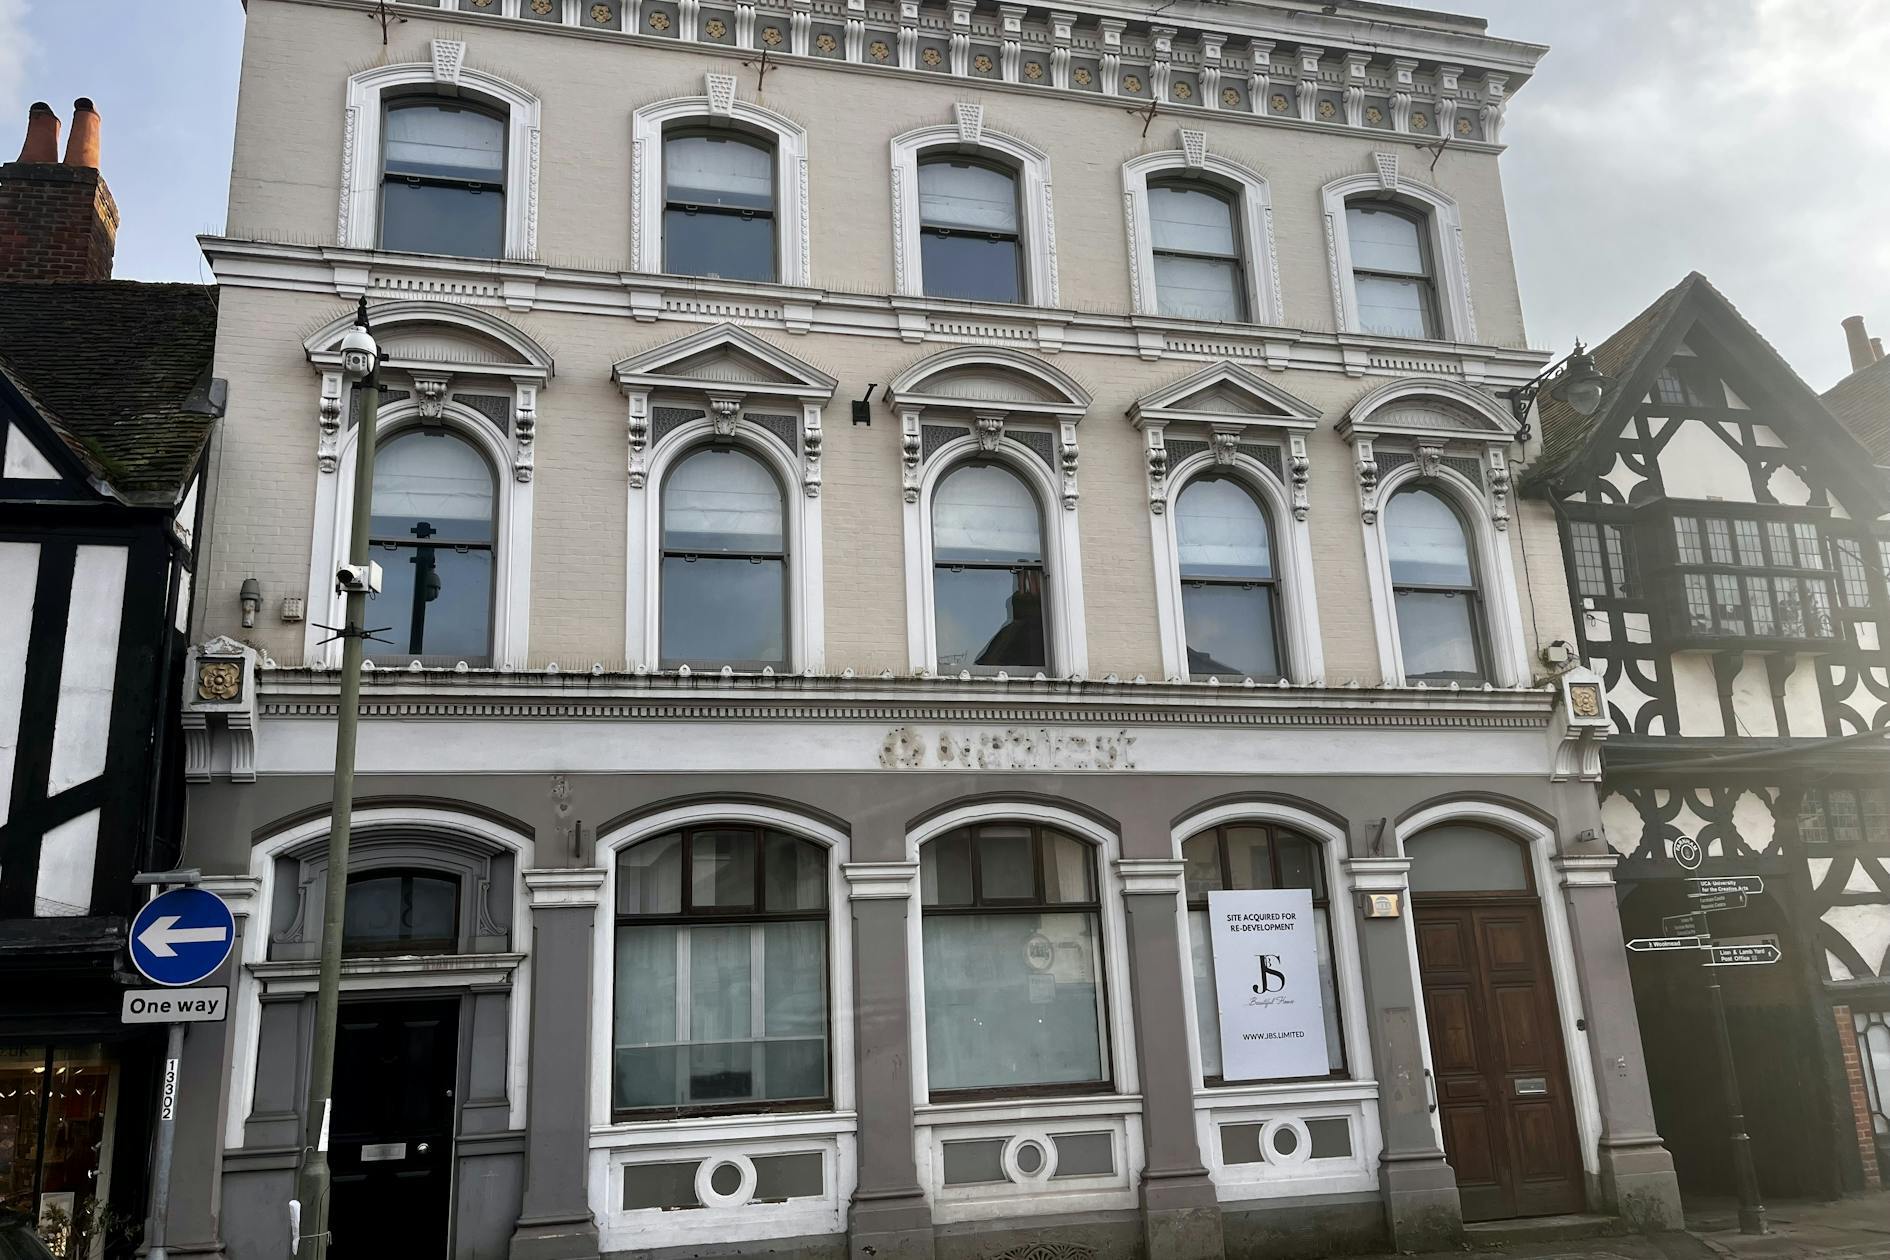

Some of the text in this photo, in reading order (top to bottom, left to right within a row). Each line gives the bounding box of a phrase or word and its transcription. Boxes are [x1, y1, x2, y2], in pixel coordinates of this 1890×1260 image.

[1227, 912, 1296, 922] SITE ACQUIRED FOR
[1230, 924, 1294, 932] RE-DEVELOPMENT
[130, 998, 219, 1014] One way
[1242, 1031, 1304, 1040] WWW.JBS.LIMITED
[162, 1060, 176, 1119] 13302
